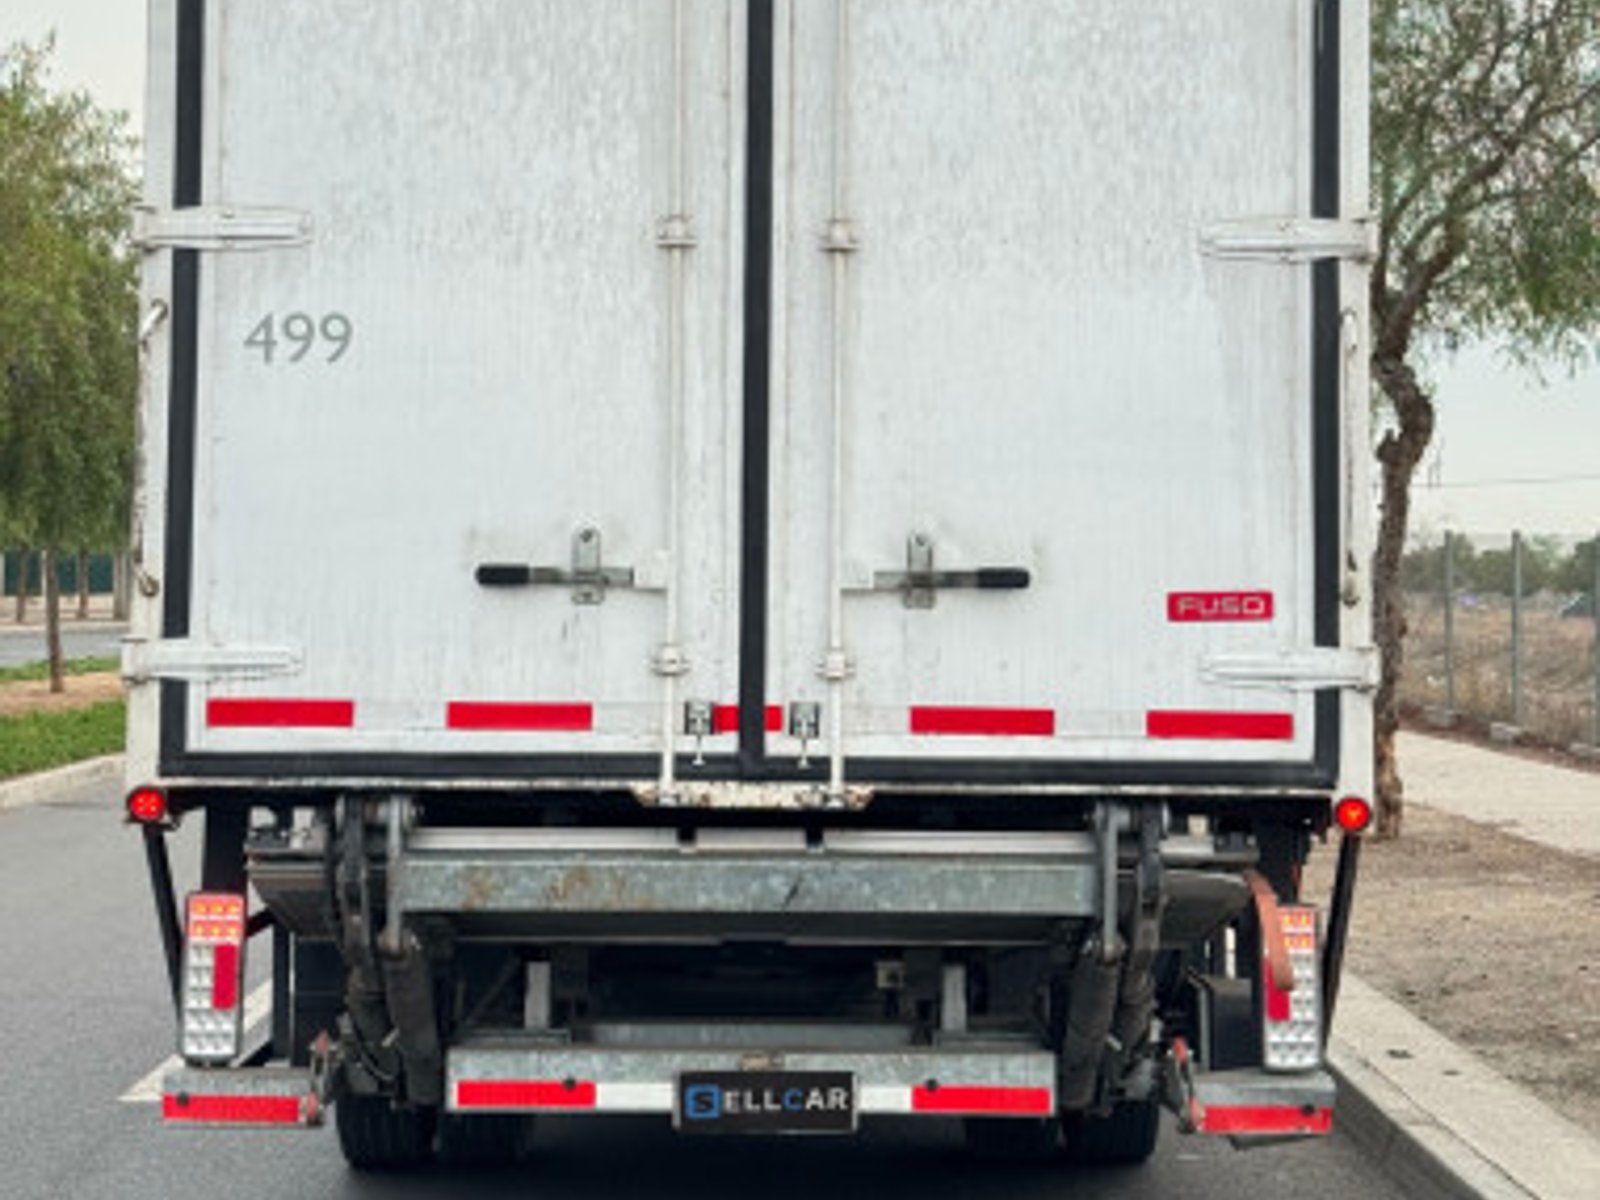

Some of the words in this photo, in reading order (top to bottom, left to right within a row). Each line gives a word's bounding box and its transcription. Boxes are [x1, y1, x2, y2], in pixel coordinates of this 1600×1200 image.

[243, 311, 353, 364] 499
[1177, 595, 1266, 616] FUSO
[685, 1084, 848, 1118] SELLCAR
